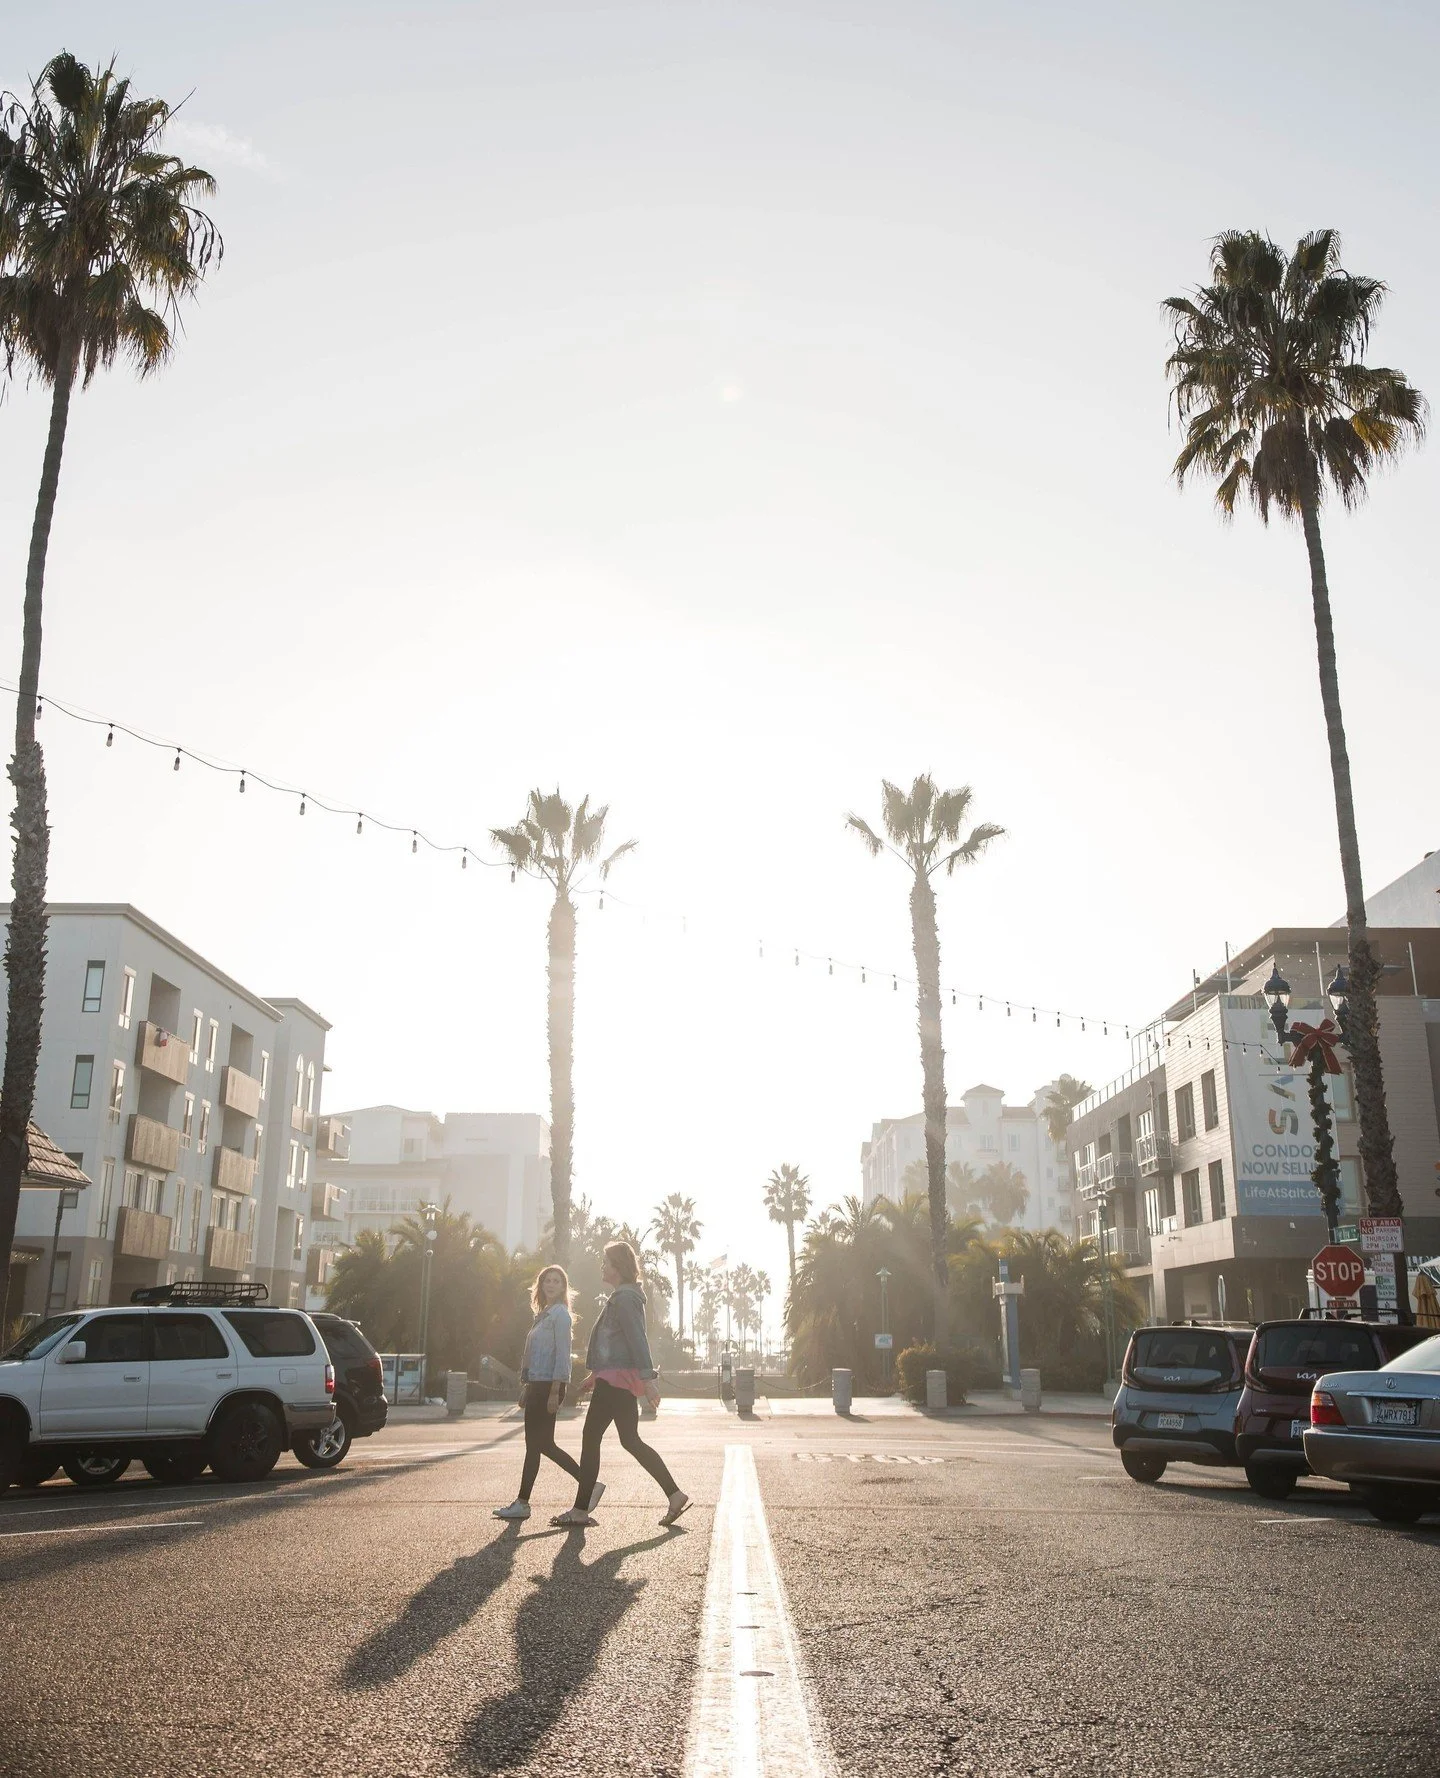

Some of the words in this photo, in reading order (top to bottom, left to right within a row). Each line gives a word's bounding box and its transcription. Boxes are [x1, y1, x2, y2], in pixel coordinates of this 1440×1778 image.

[1243, 1162, 1279, 1175] NOW
[1245, 1187, 1323, 1200] LifeAtSalt.co
[1362, 1219, 1377, 1227] TOW
[1380, 1219, 1399, 1227] AWAY
[1316, 1262, 1361, 1281] STOP
[1296, 1372, 1317, 1380] KIA
[796, 1453, 945, 1465] STOP
